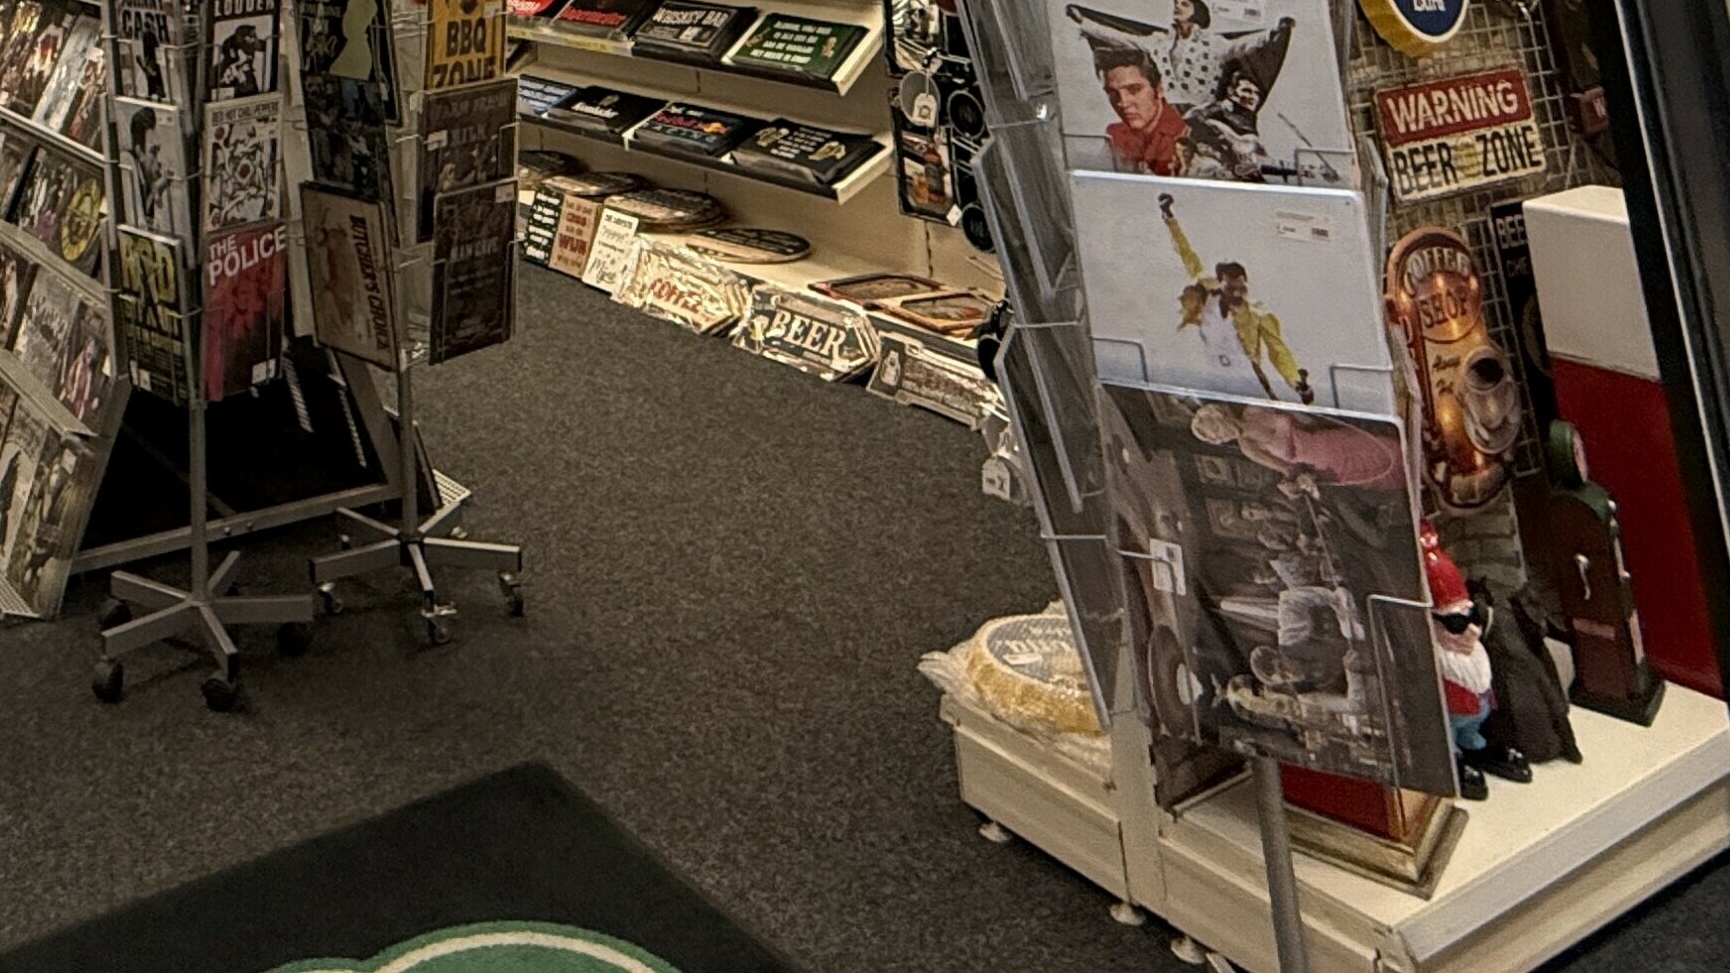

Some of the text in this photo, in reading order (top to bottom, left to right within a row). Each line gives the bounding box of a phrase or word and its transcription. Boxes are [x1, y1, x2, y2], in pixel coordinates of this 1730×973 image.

[447, 21, 487, 54] BBQ
[1387, 80, 1520, 134] WARNING
[1393, 124, 1543, 196] BEER ZONE
[209, 233, 238, 261] THE
[209, 225, 287, 286] POLICE
[1420, 286, 1469, 328] SHOP
[770, 311, 846, 367] BEER
